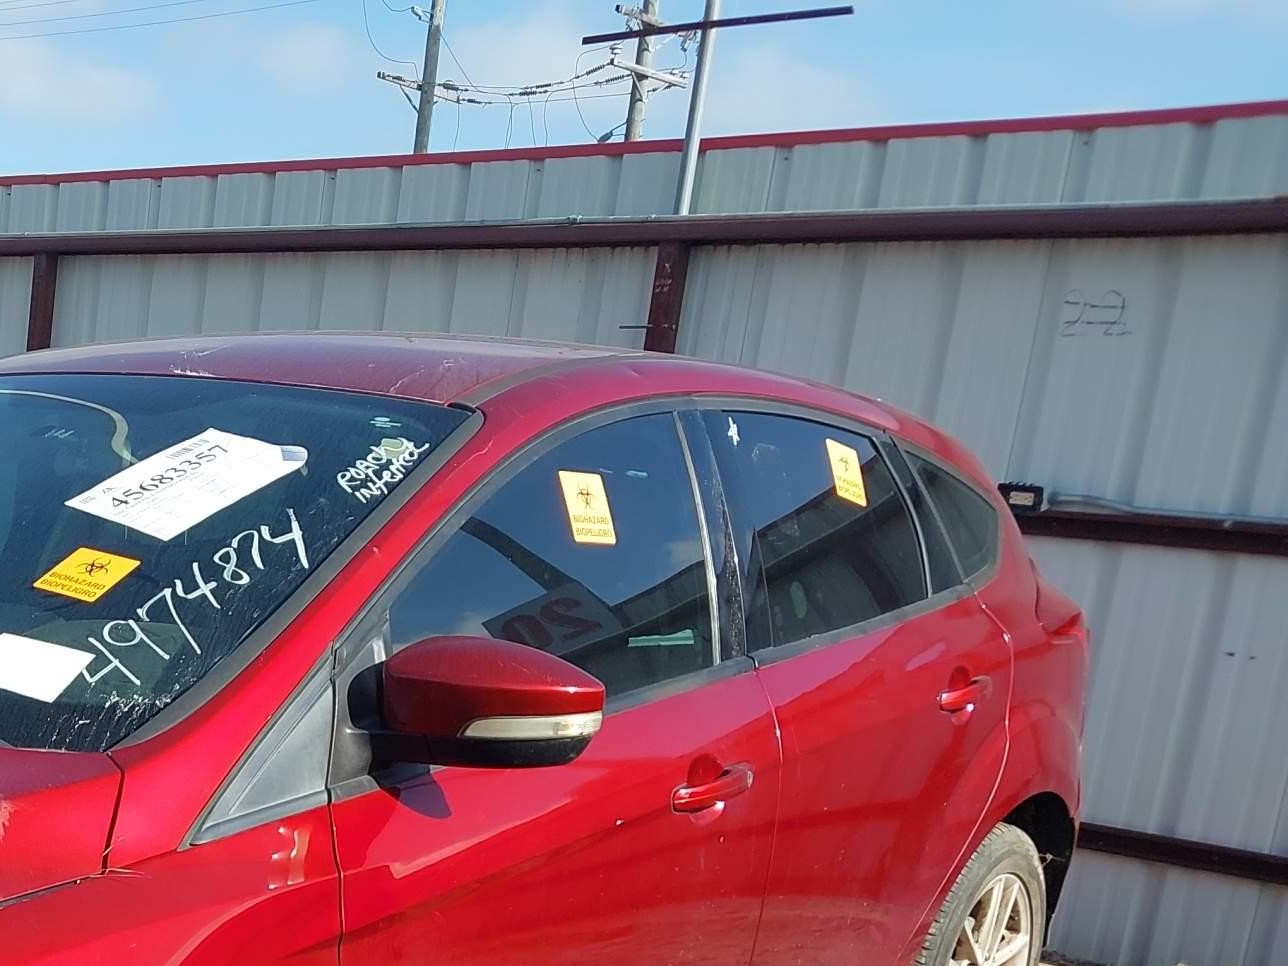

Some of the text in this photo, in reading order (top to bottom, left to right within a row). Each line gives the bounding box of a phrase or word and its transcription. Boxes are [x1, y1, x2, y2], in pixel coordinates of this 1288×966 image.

[111, 444, 229, 508] 45683357
[40, 579, 97, 598] BIOPELIGRO
[49, 571, 106, 591] BIOHAZARD
[82, 508, 310, 686] 4974874
